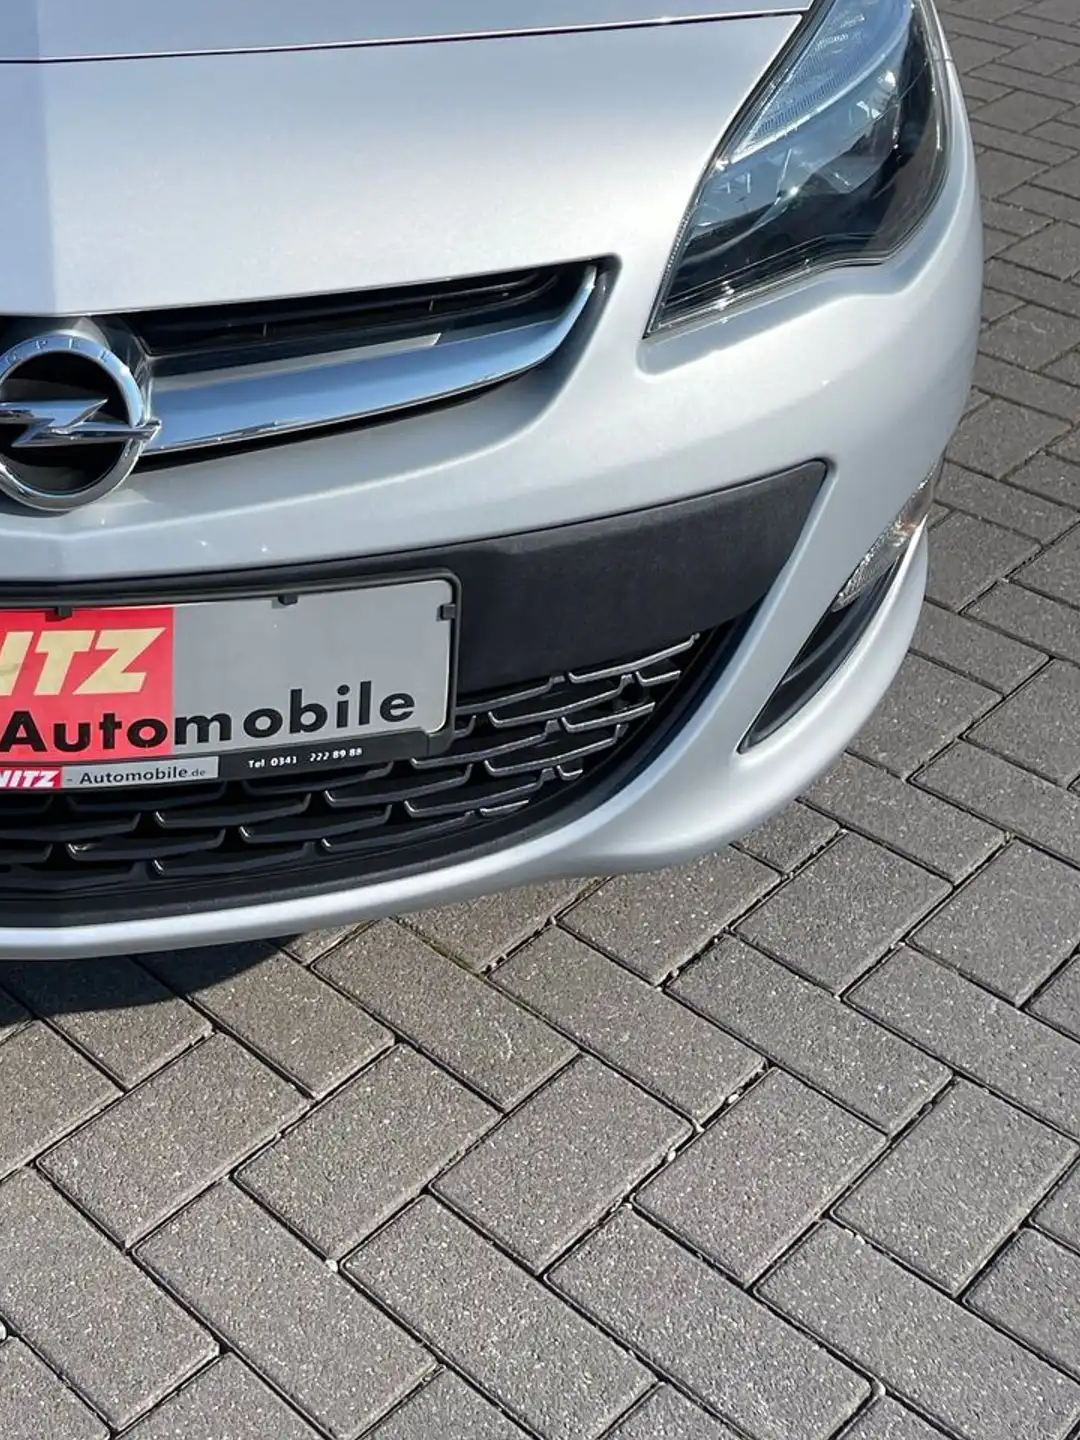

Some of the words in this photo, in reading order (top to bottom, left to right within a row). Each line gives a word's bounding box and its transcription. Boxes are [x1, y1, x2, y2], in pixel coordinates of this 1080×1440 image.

[270, 756, 297, 767] 0341
[310, 751, 329, 762] 222
[332, 749, 347, 759] 89
